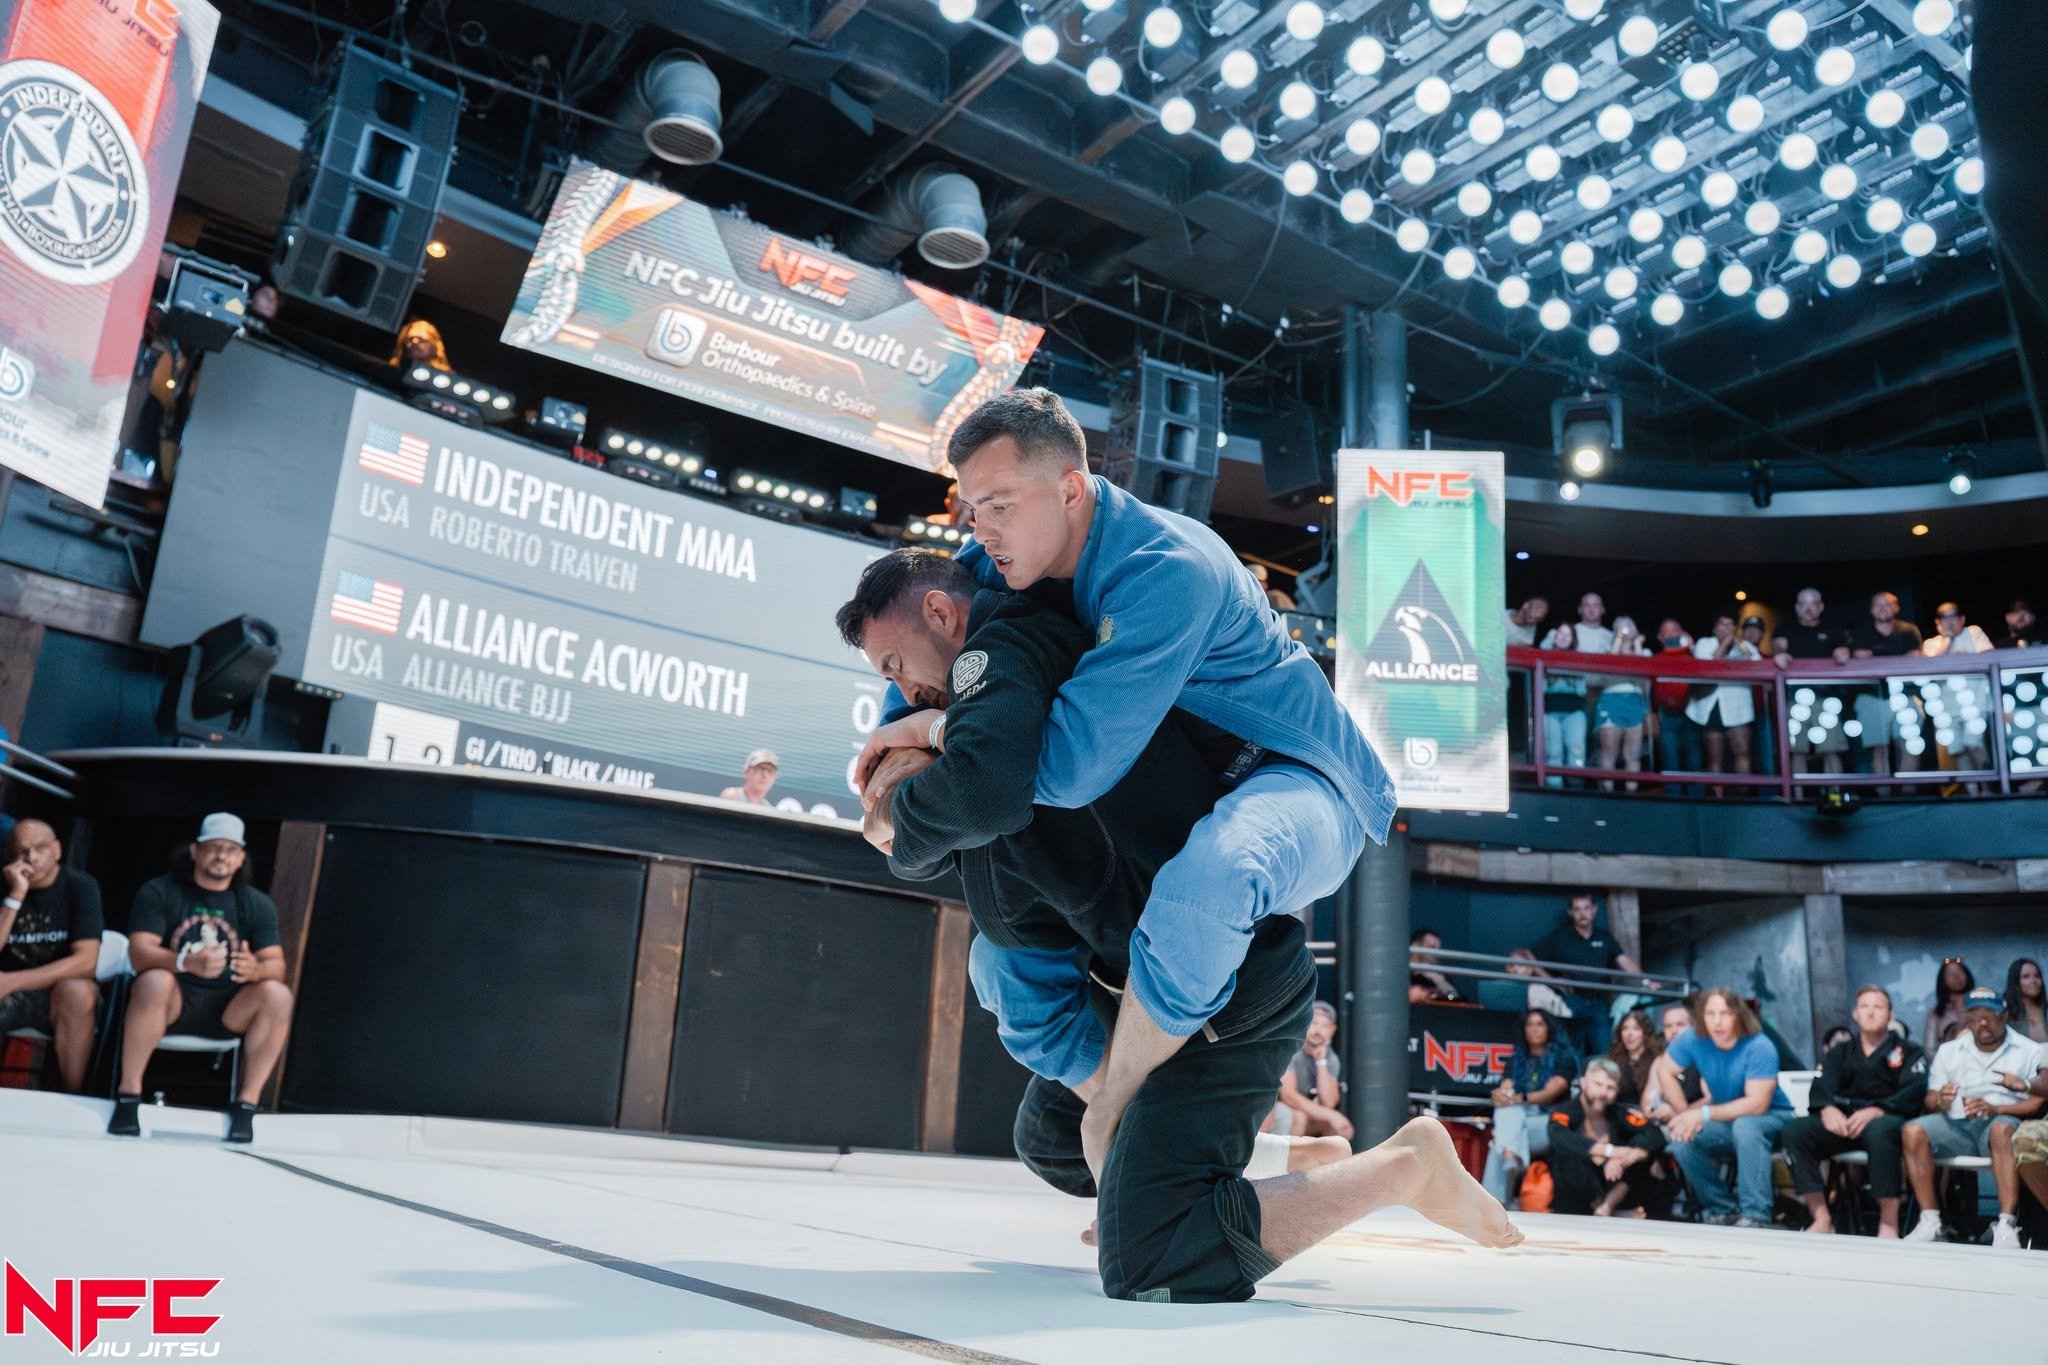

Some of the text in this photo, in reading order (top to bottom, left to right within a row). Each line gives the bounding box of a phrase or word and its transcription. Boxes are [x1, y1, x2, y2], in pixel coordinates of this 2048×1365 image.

[14, 86, 128, 174] INDEPENDENT
[760, 236, 858, 297] NFC
[624, 250, 951, 386] NFC Jiu Jitsu built by
[708, 331, 782, 368] Barbour
[701, 350, 815, 399] Orthopaedics
[434, 447, 757, 583] INDEPENDENT MMA
[1365, 464, 1475, 507] NFC
[360, 483, 639, 593] USA ROBERTO TRAVEN
[330, 634, 572, 725] USA ALLIANCE BJJ
[406, 594, 749, 717] ALLIANCE ACWORTH
[1366, 662, 1478, 681] ALLIANCE
[1424, 1031, 1514, 1081] NFC
